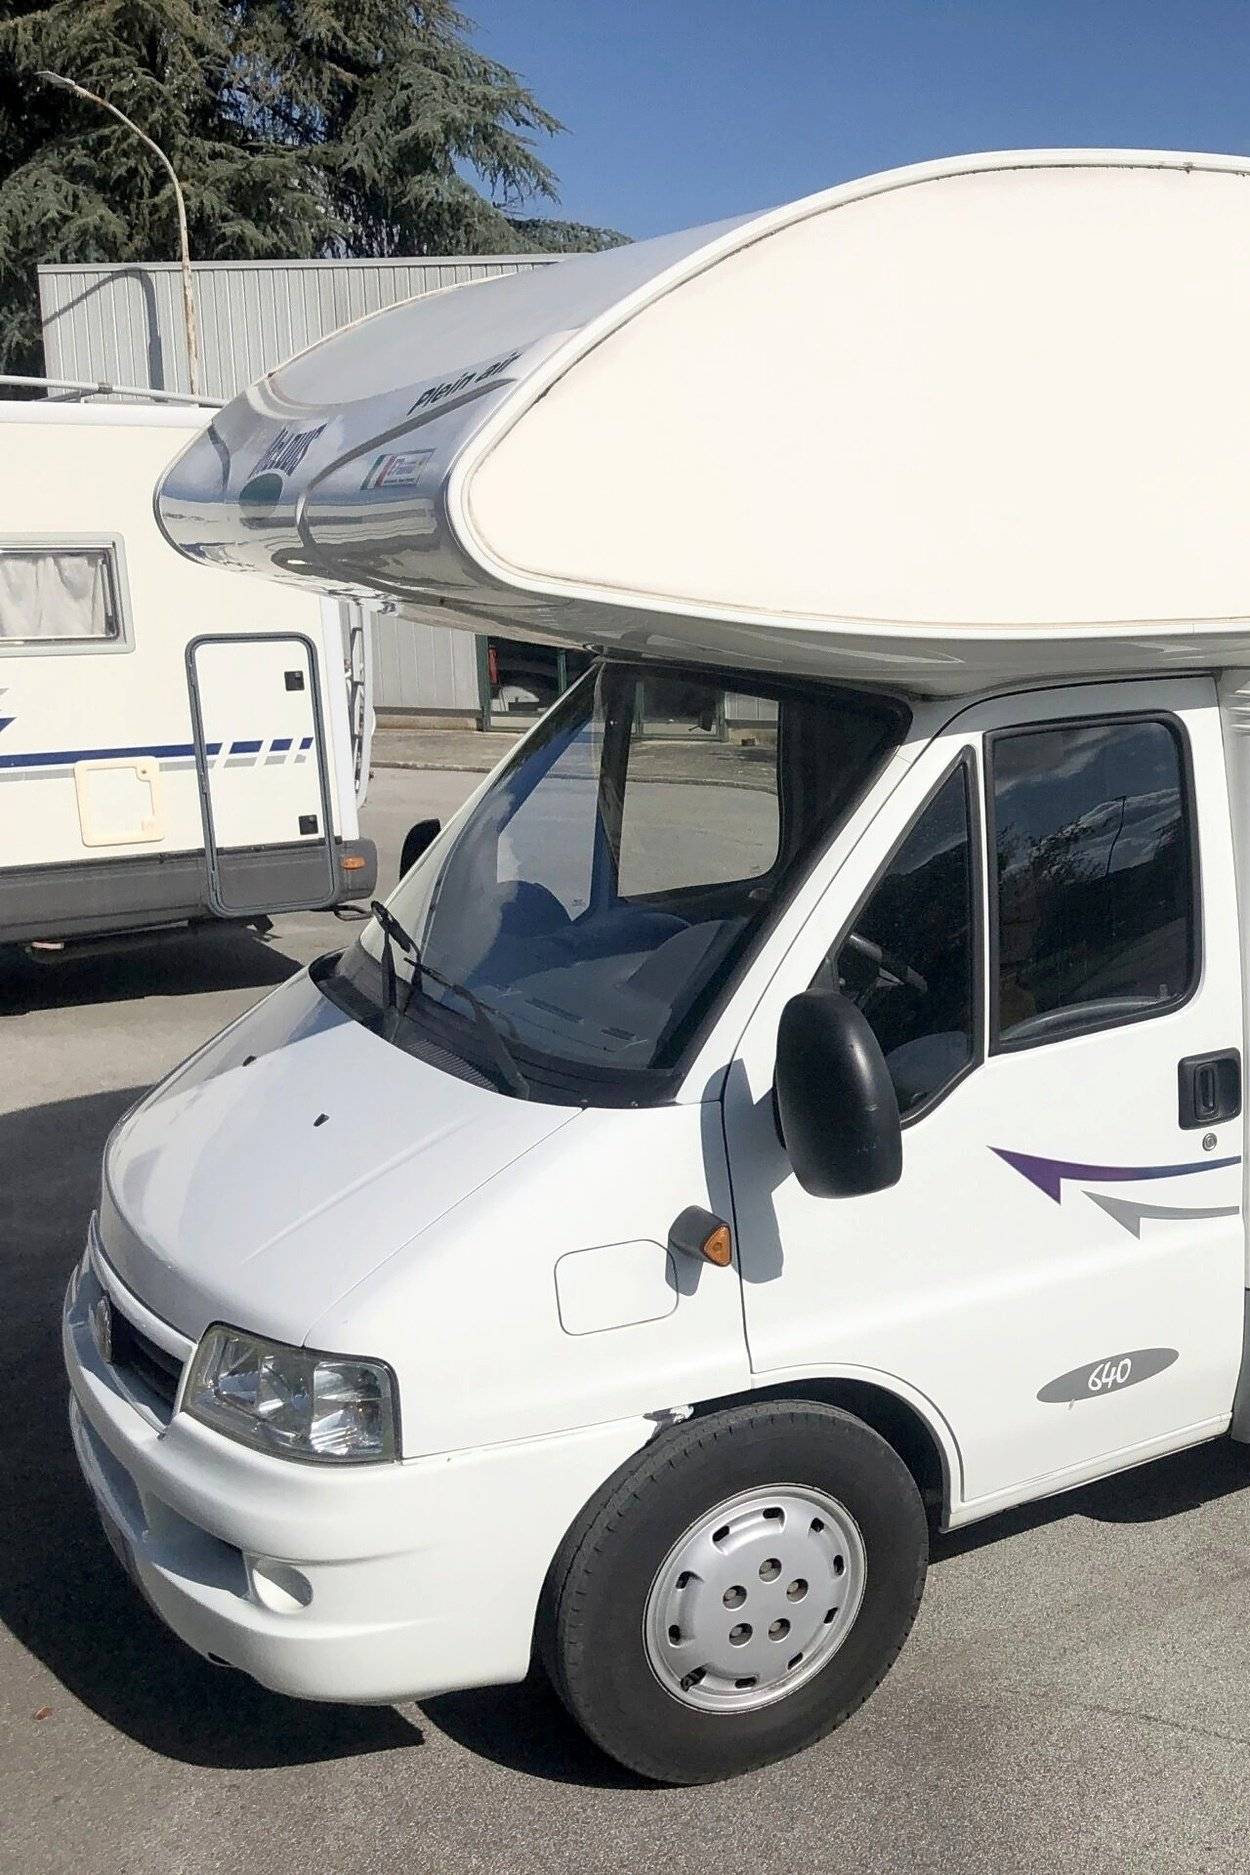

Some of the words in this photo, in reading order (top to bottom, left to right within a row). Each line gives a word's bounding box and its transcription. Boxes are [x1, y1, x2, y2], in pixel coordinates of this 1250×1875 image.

[406, 372, 477, 416] Plein
[474, 352, 522, 383] air
[1088, 1358, 1132, 1391] 640
